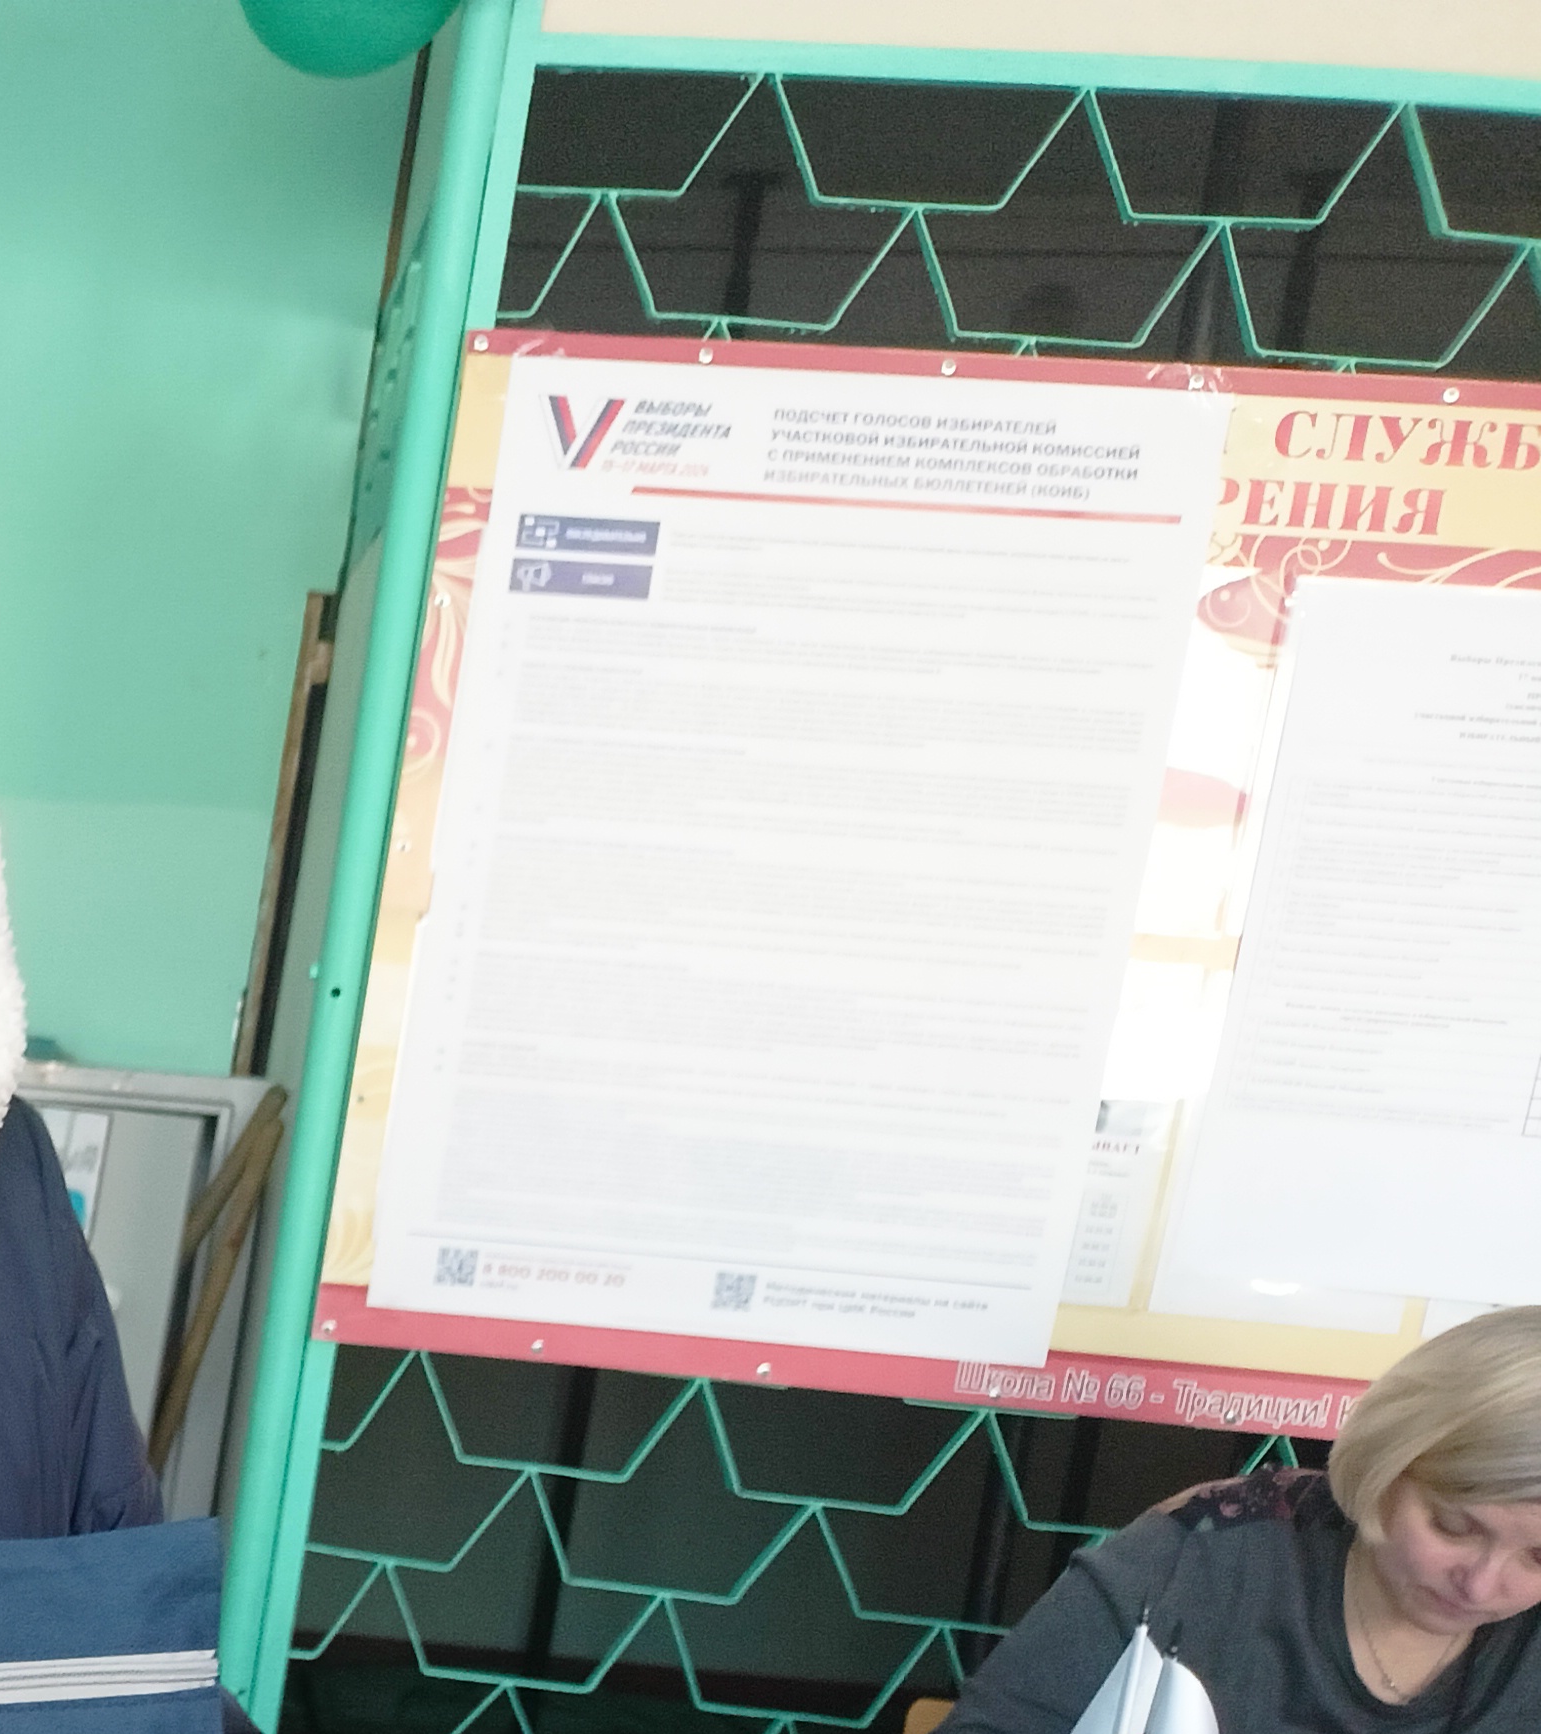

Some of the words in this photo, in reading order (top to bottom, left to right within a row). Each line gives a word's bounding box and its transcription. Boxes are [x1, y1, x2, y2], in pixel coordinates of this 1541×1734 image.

[633, 400, 713, 418] ВЫБОРЫ
[773, 408, 849, 425] ПОДСЧЕТ
[853, 413, 932, 430] ГОЛОСОВ
[936, 416, 1057, 436] ИЗБИРАТЕЛЕЙ
[622, 420, 732, 440] ПРЕЗИДЕНТА
[611, 440, 681, 457] РОССИИ
[771, 428, 880, 446] УЧАСТКОВОЙ
[883, 434, 1028, 454] ИЗБИРАТЕЛЬНОЙ
[1031, 442, 1141, 461] КОМИССИЕЙ
[767, 449, 778, 462] С
[782, 450, 911, 469] ПРИМЕНЕНИЕМ
[915, 456, 1032, 477] КОМПЛЕКСОВ
[1036, 462, 1139, 481] ОБРАБОТКИ
[763, 470, 909, 490] ИЗБИРАТЕЛЬНЫХ
[913, 475, 1028, 495] БЮЛЛЕТЕНЕЙ
[954, 1359, 1055, 1401] Школа
[1060, 1367, 1102, 1405] №
[1104, 1374, 1147, 1410] 66
[1171, 1377, 1331, 1429] Традиции!
